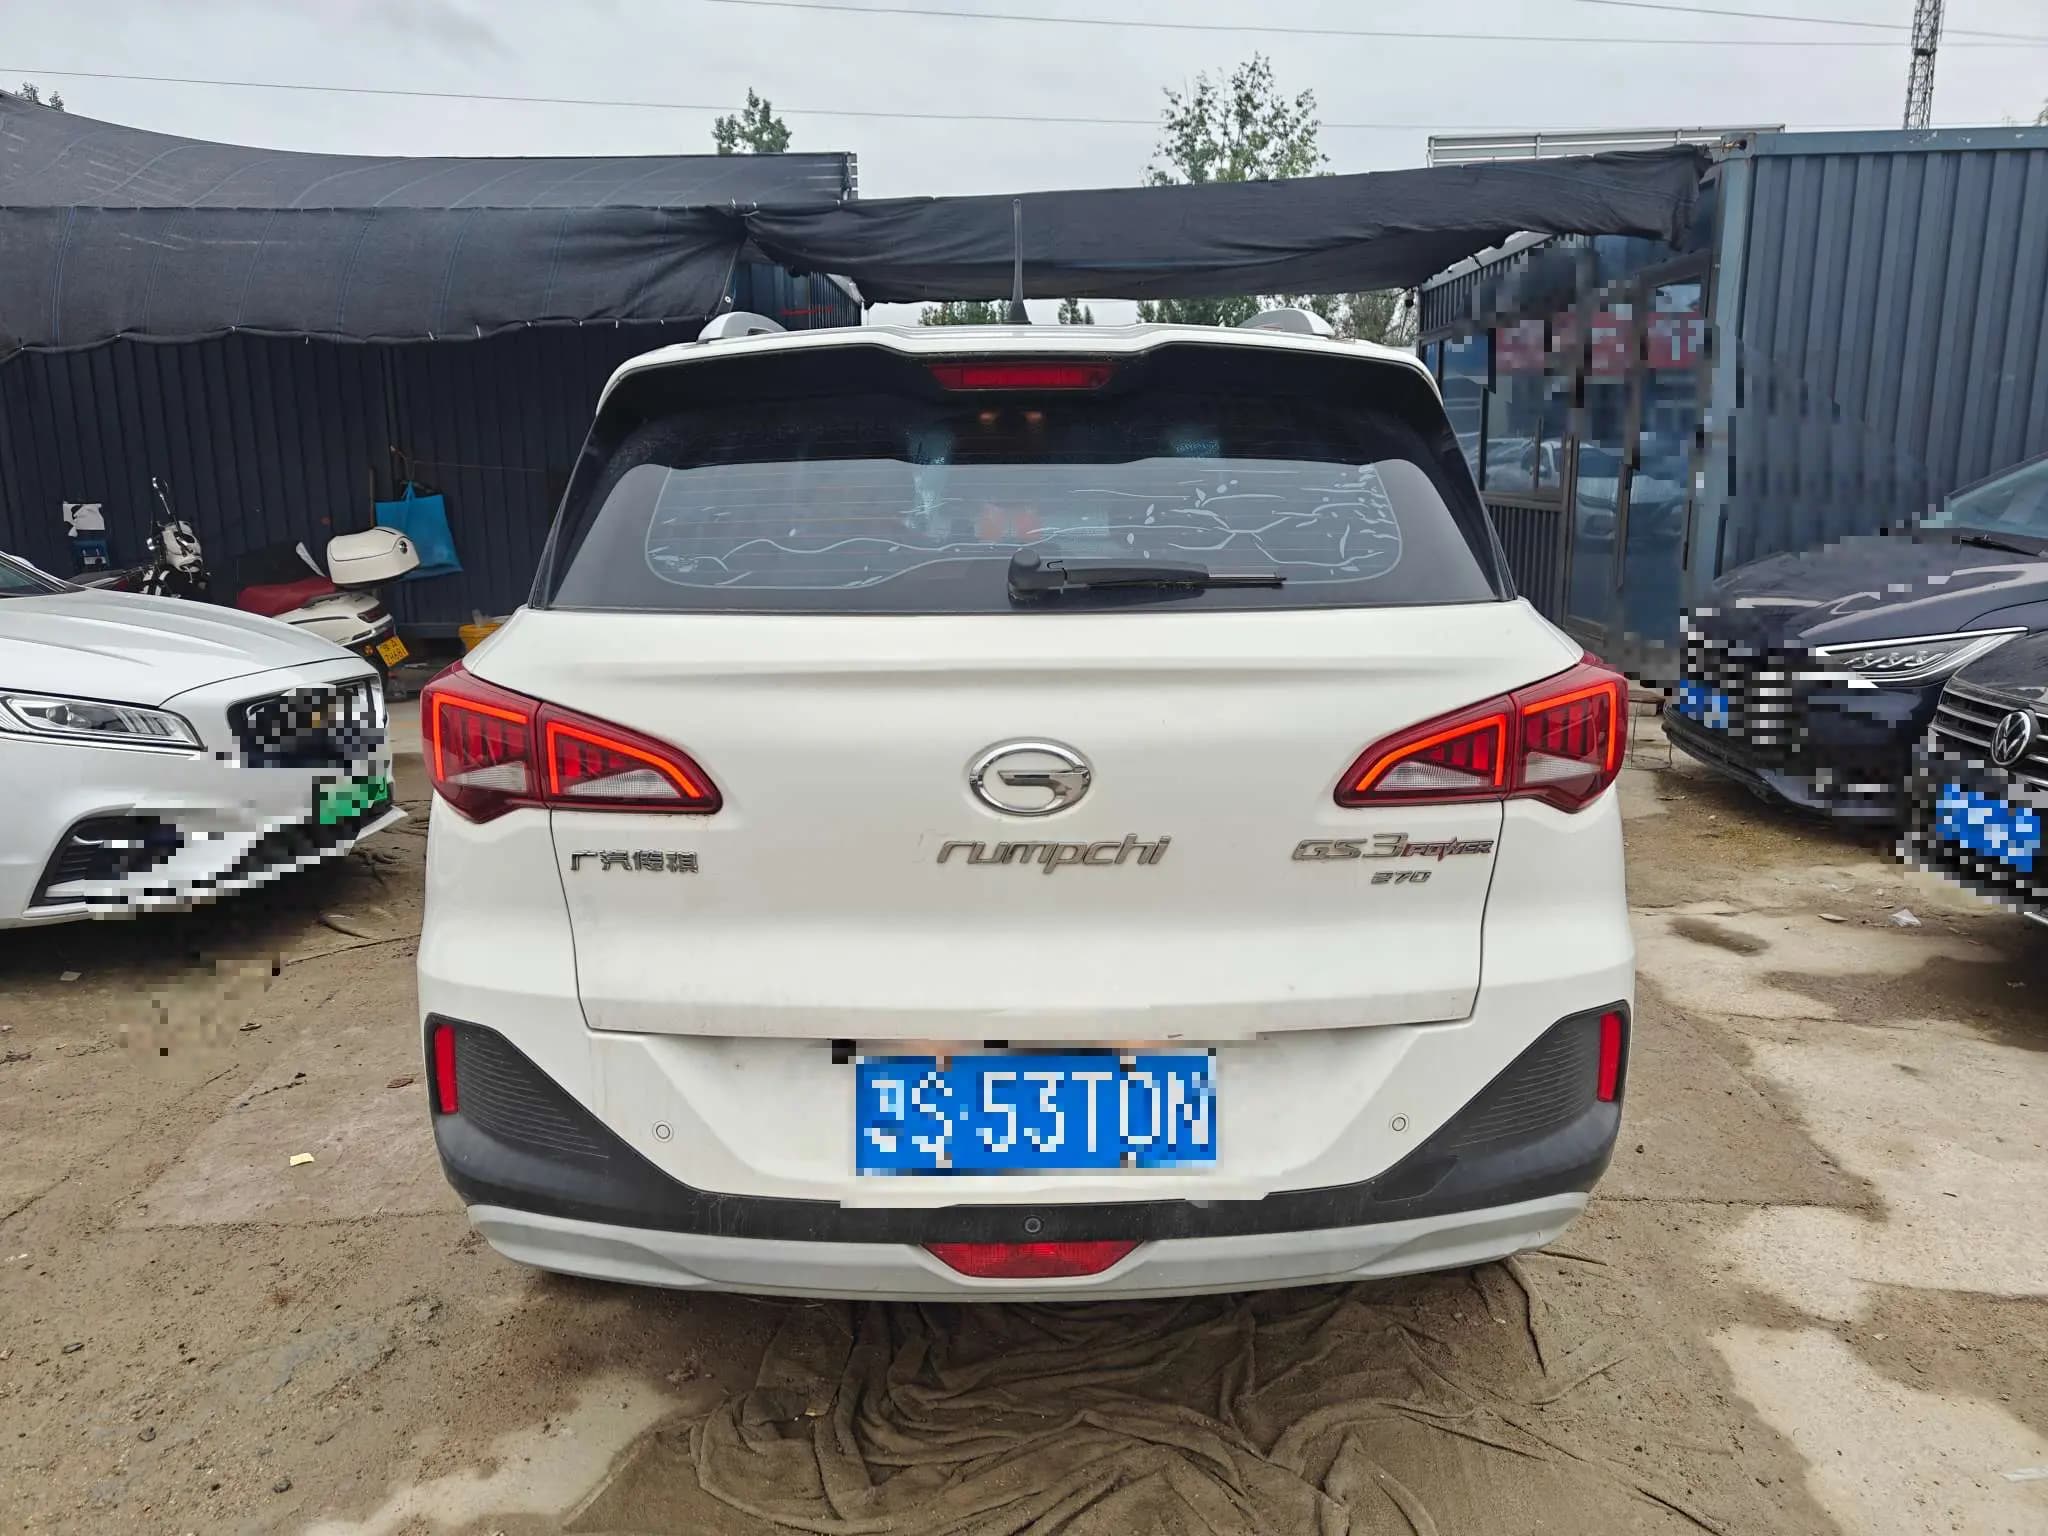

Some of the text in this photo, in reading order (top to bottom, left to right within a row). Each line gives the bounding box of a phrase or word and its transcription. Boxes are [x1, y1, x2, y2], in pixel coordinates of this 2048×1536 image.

[570, 849, 699, 873] 广汽传祺
[1370, 870, 1432, 885] 270
